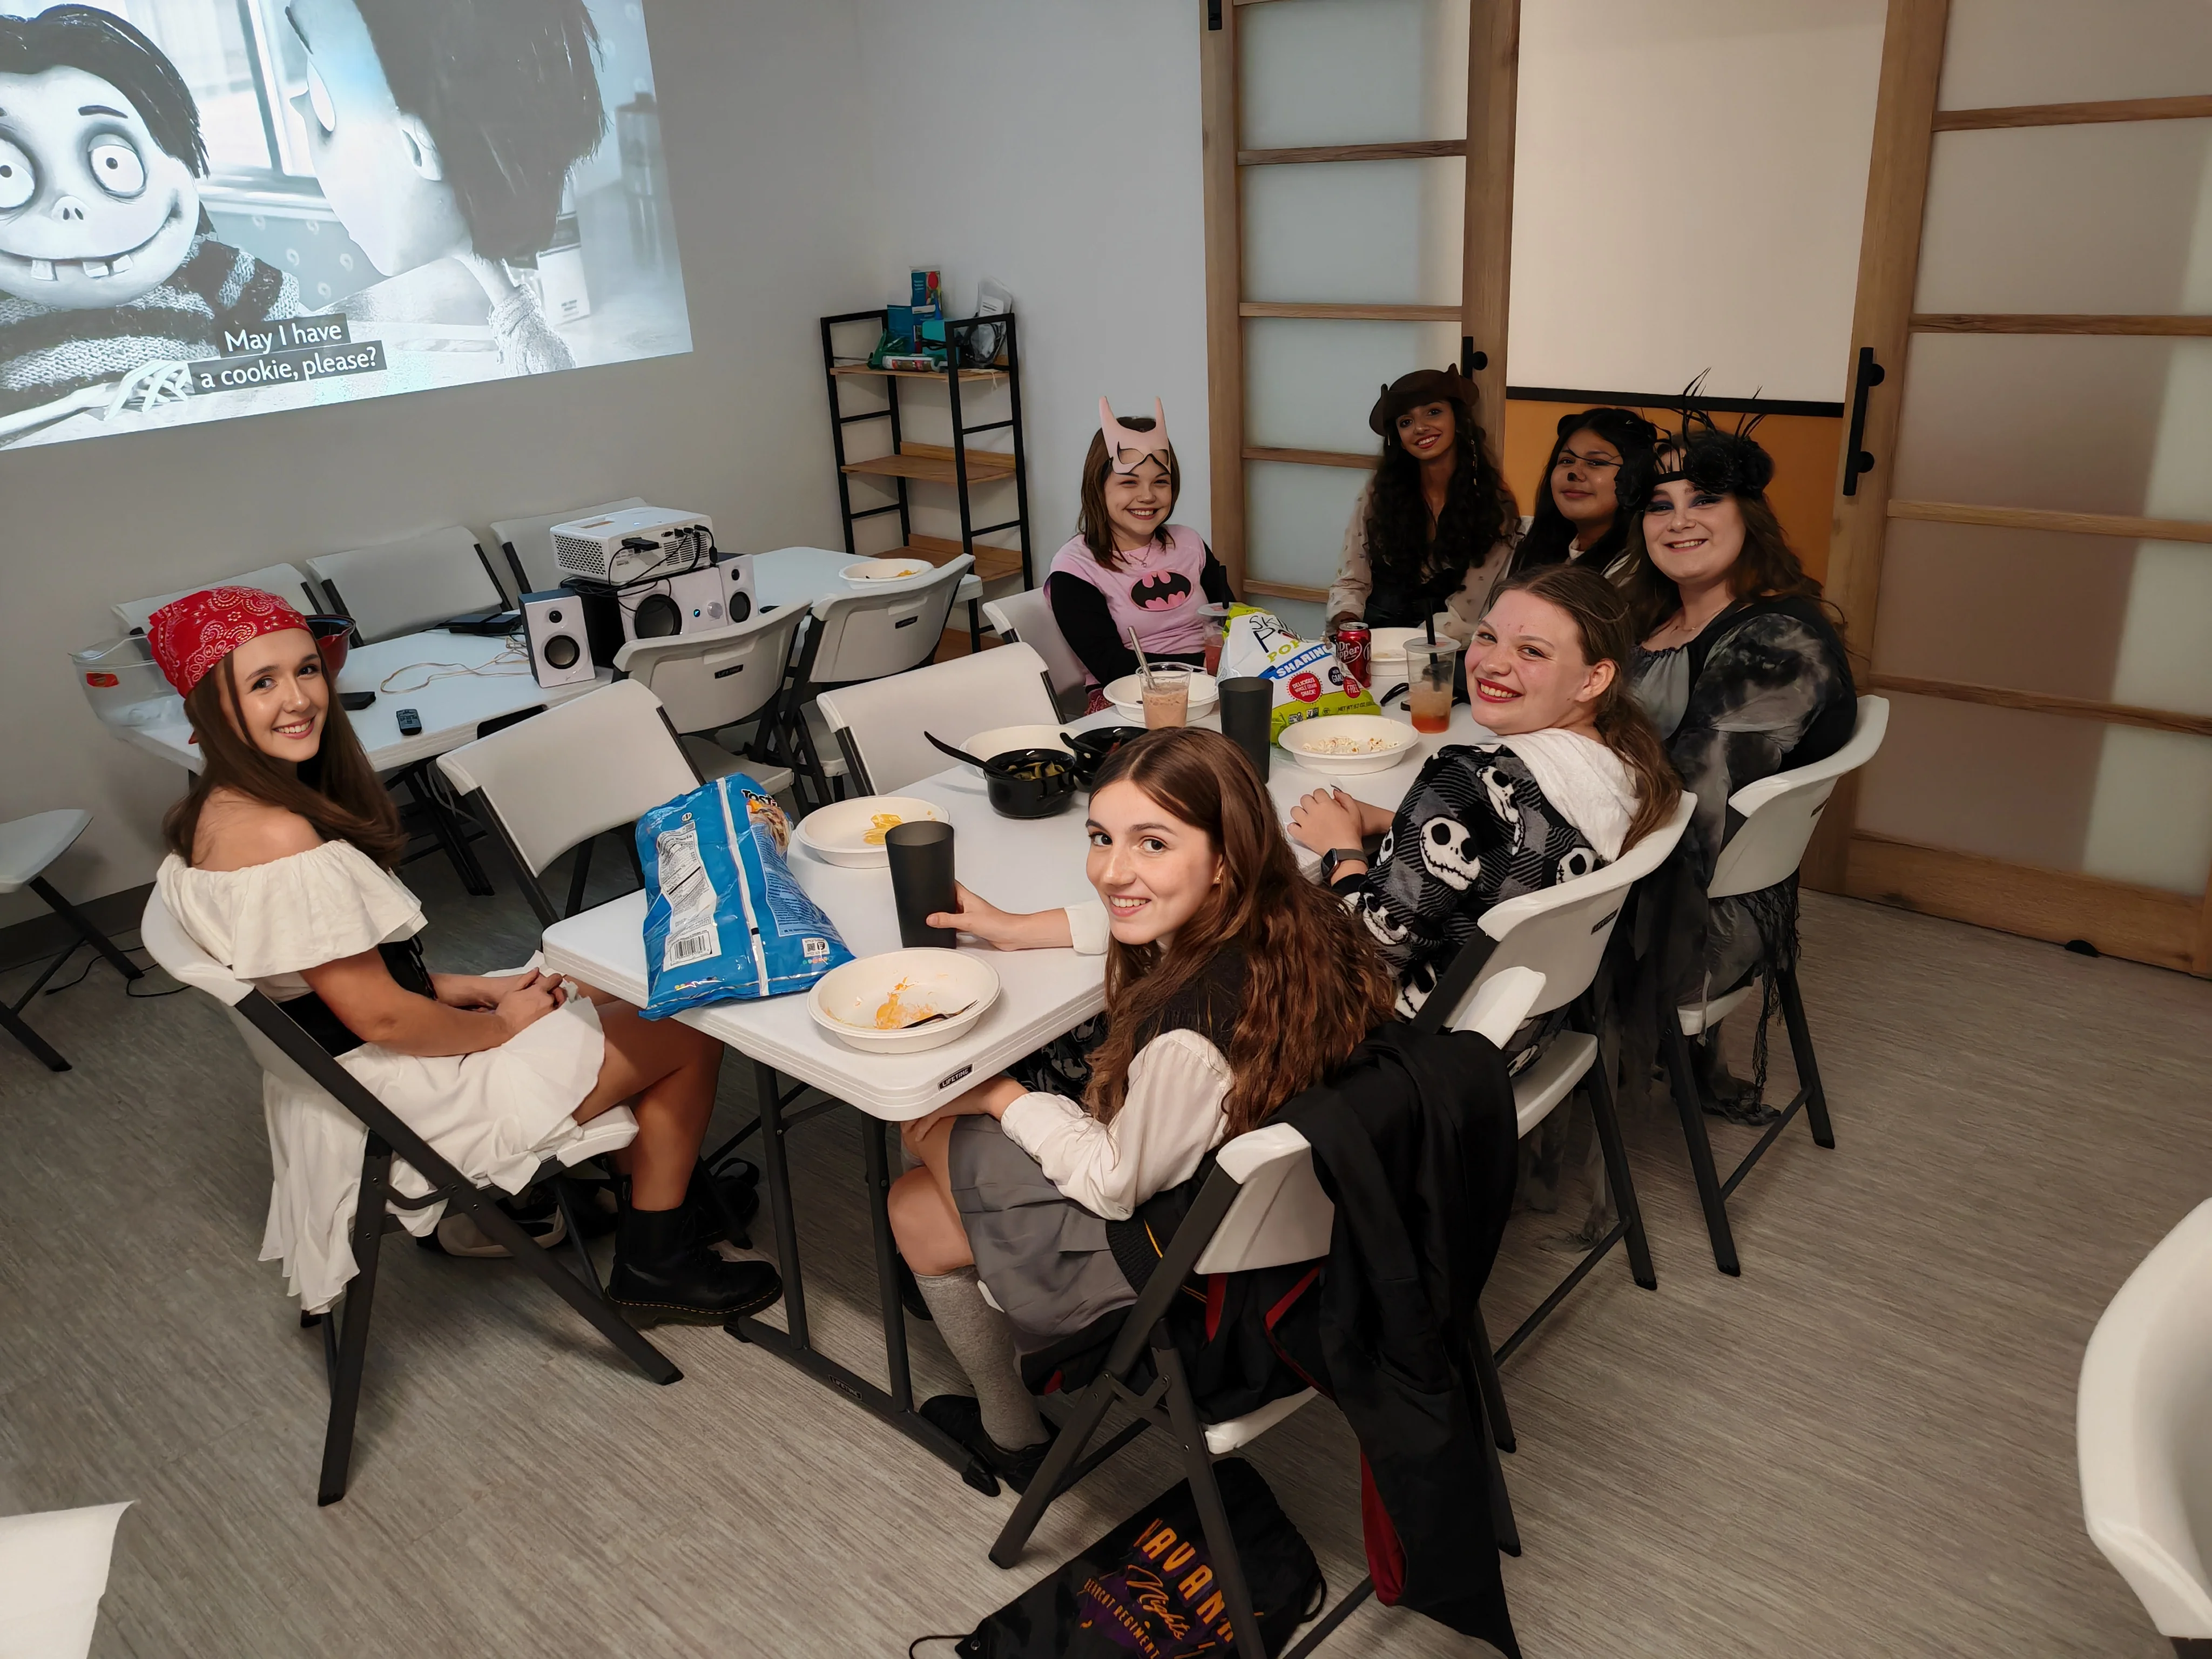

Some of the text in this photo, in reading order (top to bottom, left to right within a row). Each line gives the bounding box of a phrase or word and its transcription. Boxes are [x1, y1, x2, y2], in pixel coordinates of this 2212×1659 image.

[225, 323, 342, 354] May I have
[200, 346, 376, 389] a cookie, please?
[1339, 642, 1351, 651] Dr
[1339, 646, 1360, 660] pper
[1347, 684, 1360, 694] FREE
[1127, 1564, 1190, 1641] Nights
[1113, 1604, 1160, 1659] REGIMENT
